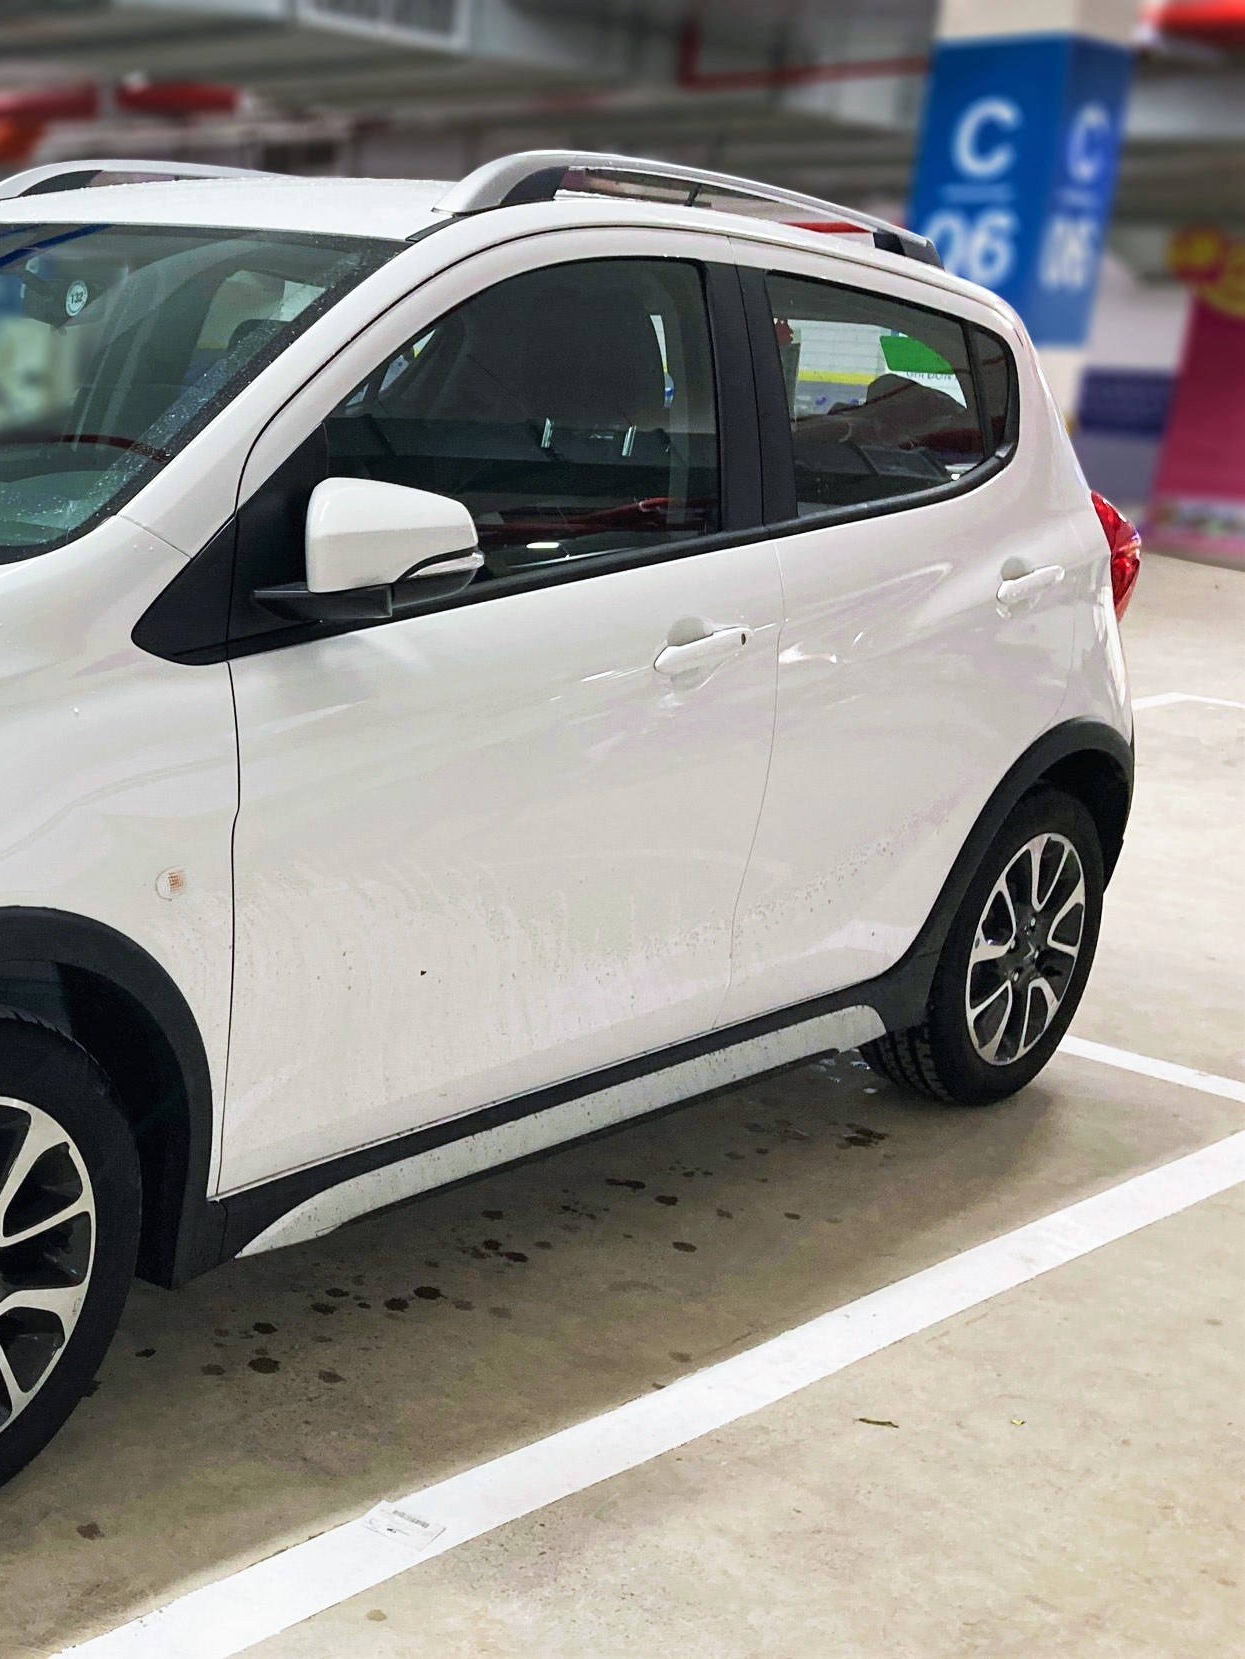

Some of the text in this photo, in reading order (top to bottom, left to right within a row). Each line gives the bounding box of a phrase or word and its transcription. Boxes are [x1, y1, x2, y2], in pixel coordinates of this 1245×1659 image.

[952, 99, 1021, 177] C
[1065, 104, 1111, 183] C
[922, 208, 1019, 288] 06
[70, 291, 84, 304] 132
